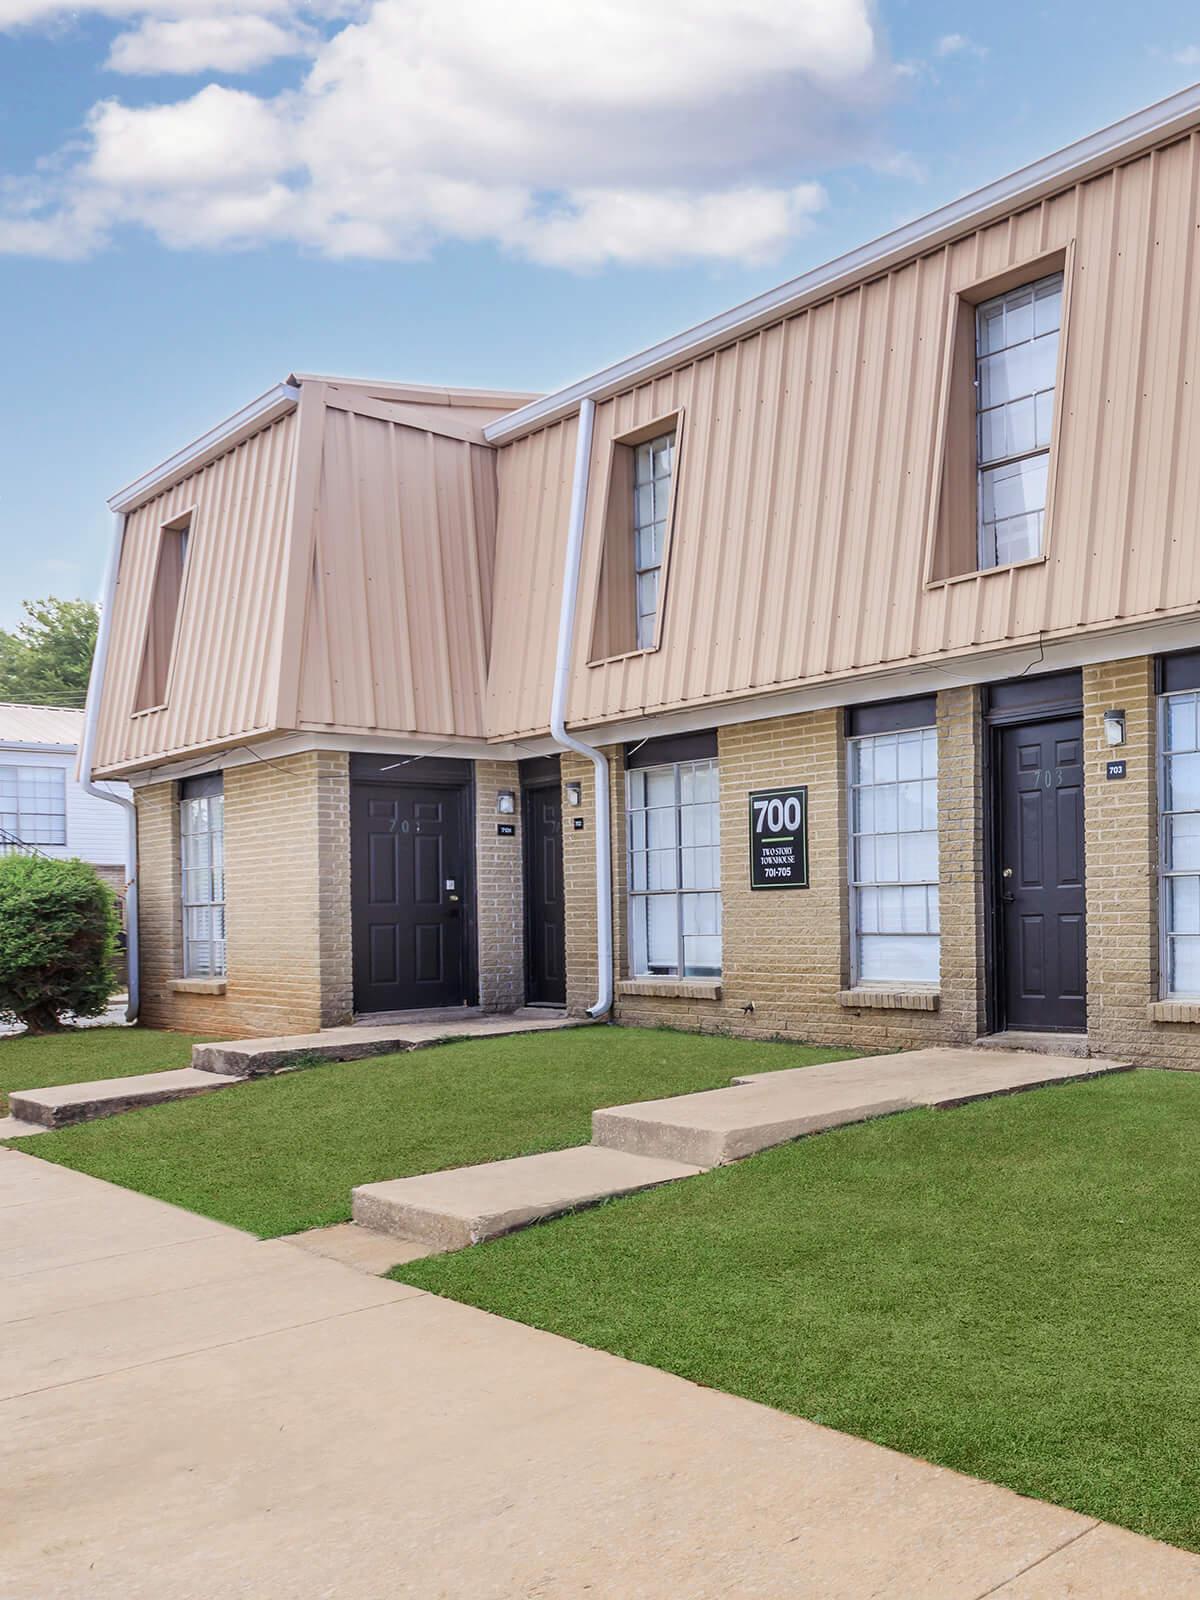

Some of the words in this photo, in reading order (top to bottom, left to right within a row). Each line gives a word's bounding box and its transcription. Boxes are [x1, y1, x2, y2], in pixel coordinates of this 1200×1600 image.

[1109, 766, 1122, 775] 703
[1034, 769, 1063, 788] 703
[753, 797, 801, 833] 700
[762, 848, 775, 856] TWO
[775, 847, 793, 855] STORY
[760, 855, 795, 865] TOWNHOUSE
[764, 867, 791, 878] 701-705
